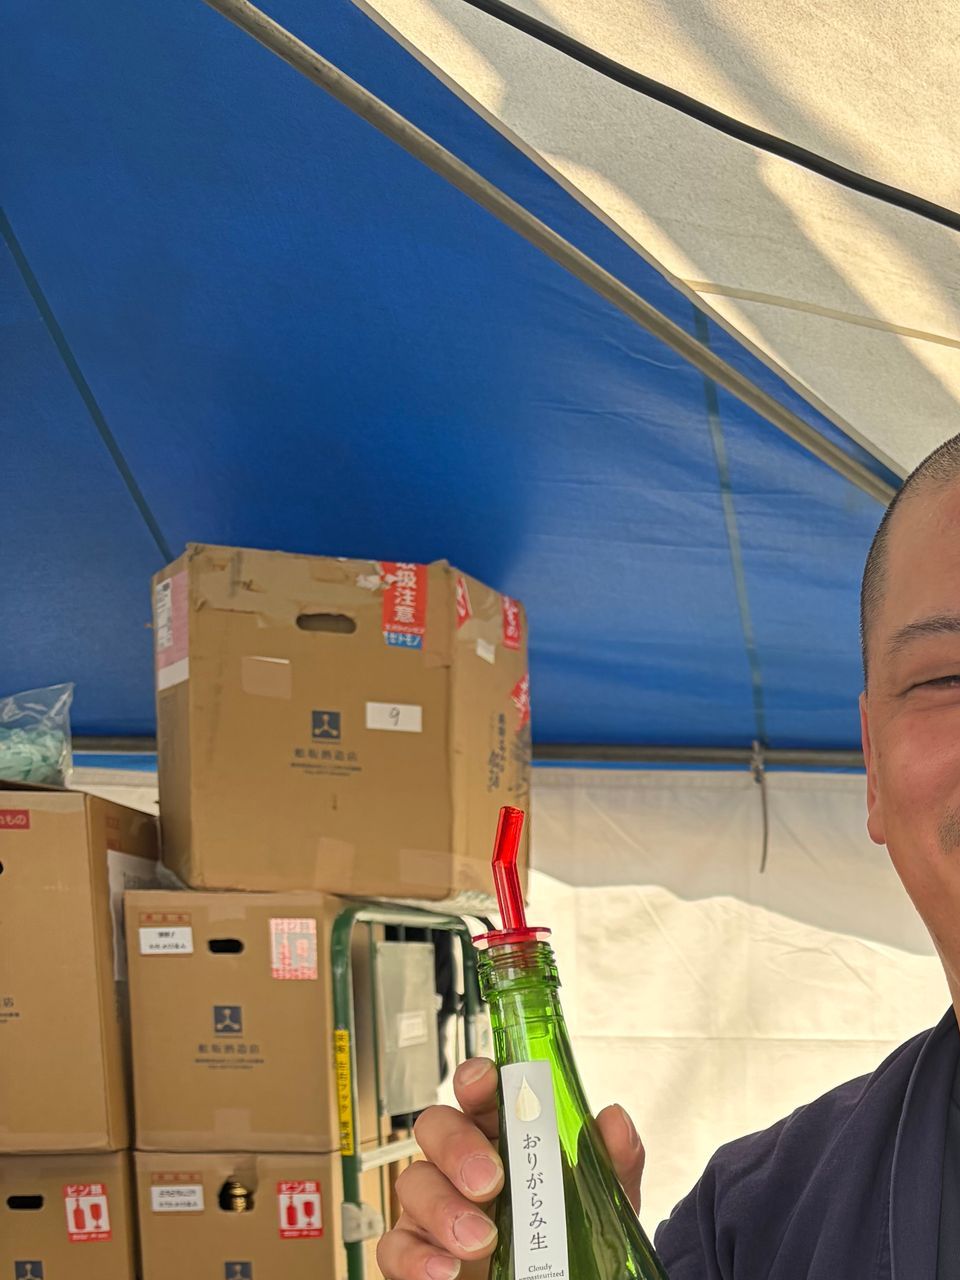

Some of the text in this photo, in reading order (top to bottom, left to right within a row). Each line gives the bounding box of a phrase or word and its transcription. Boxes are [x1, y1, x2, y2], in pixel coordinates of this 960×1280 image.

[522, 1132, 549, 1251] おりがらみ生
[528, 1263, 553, 1274] Cloudy
